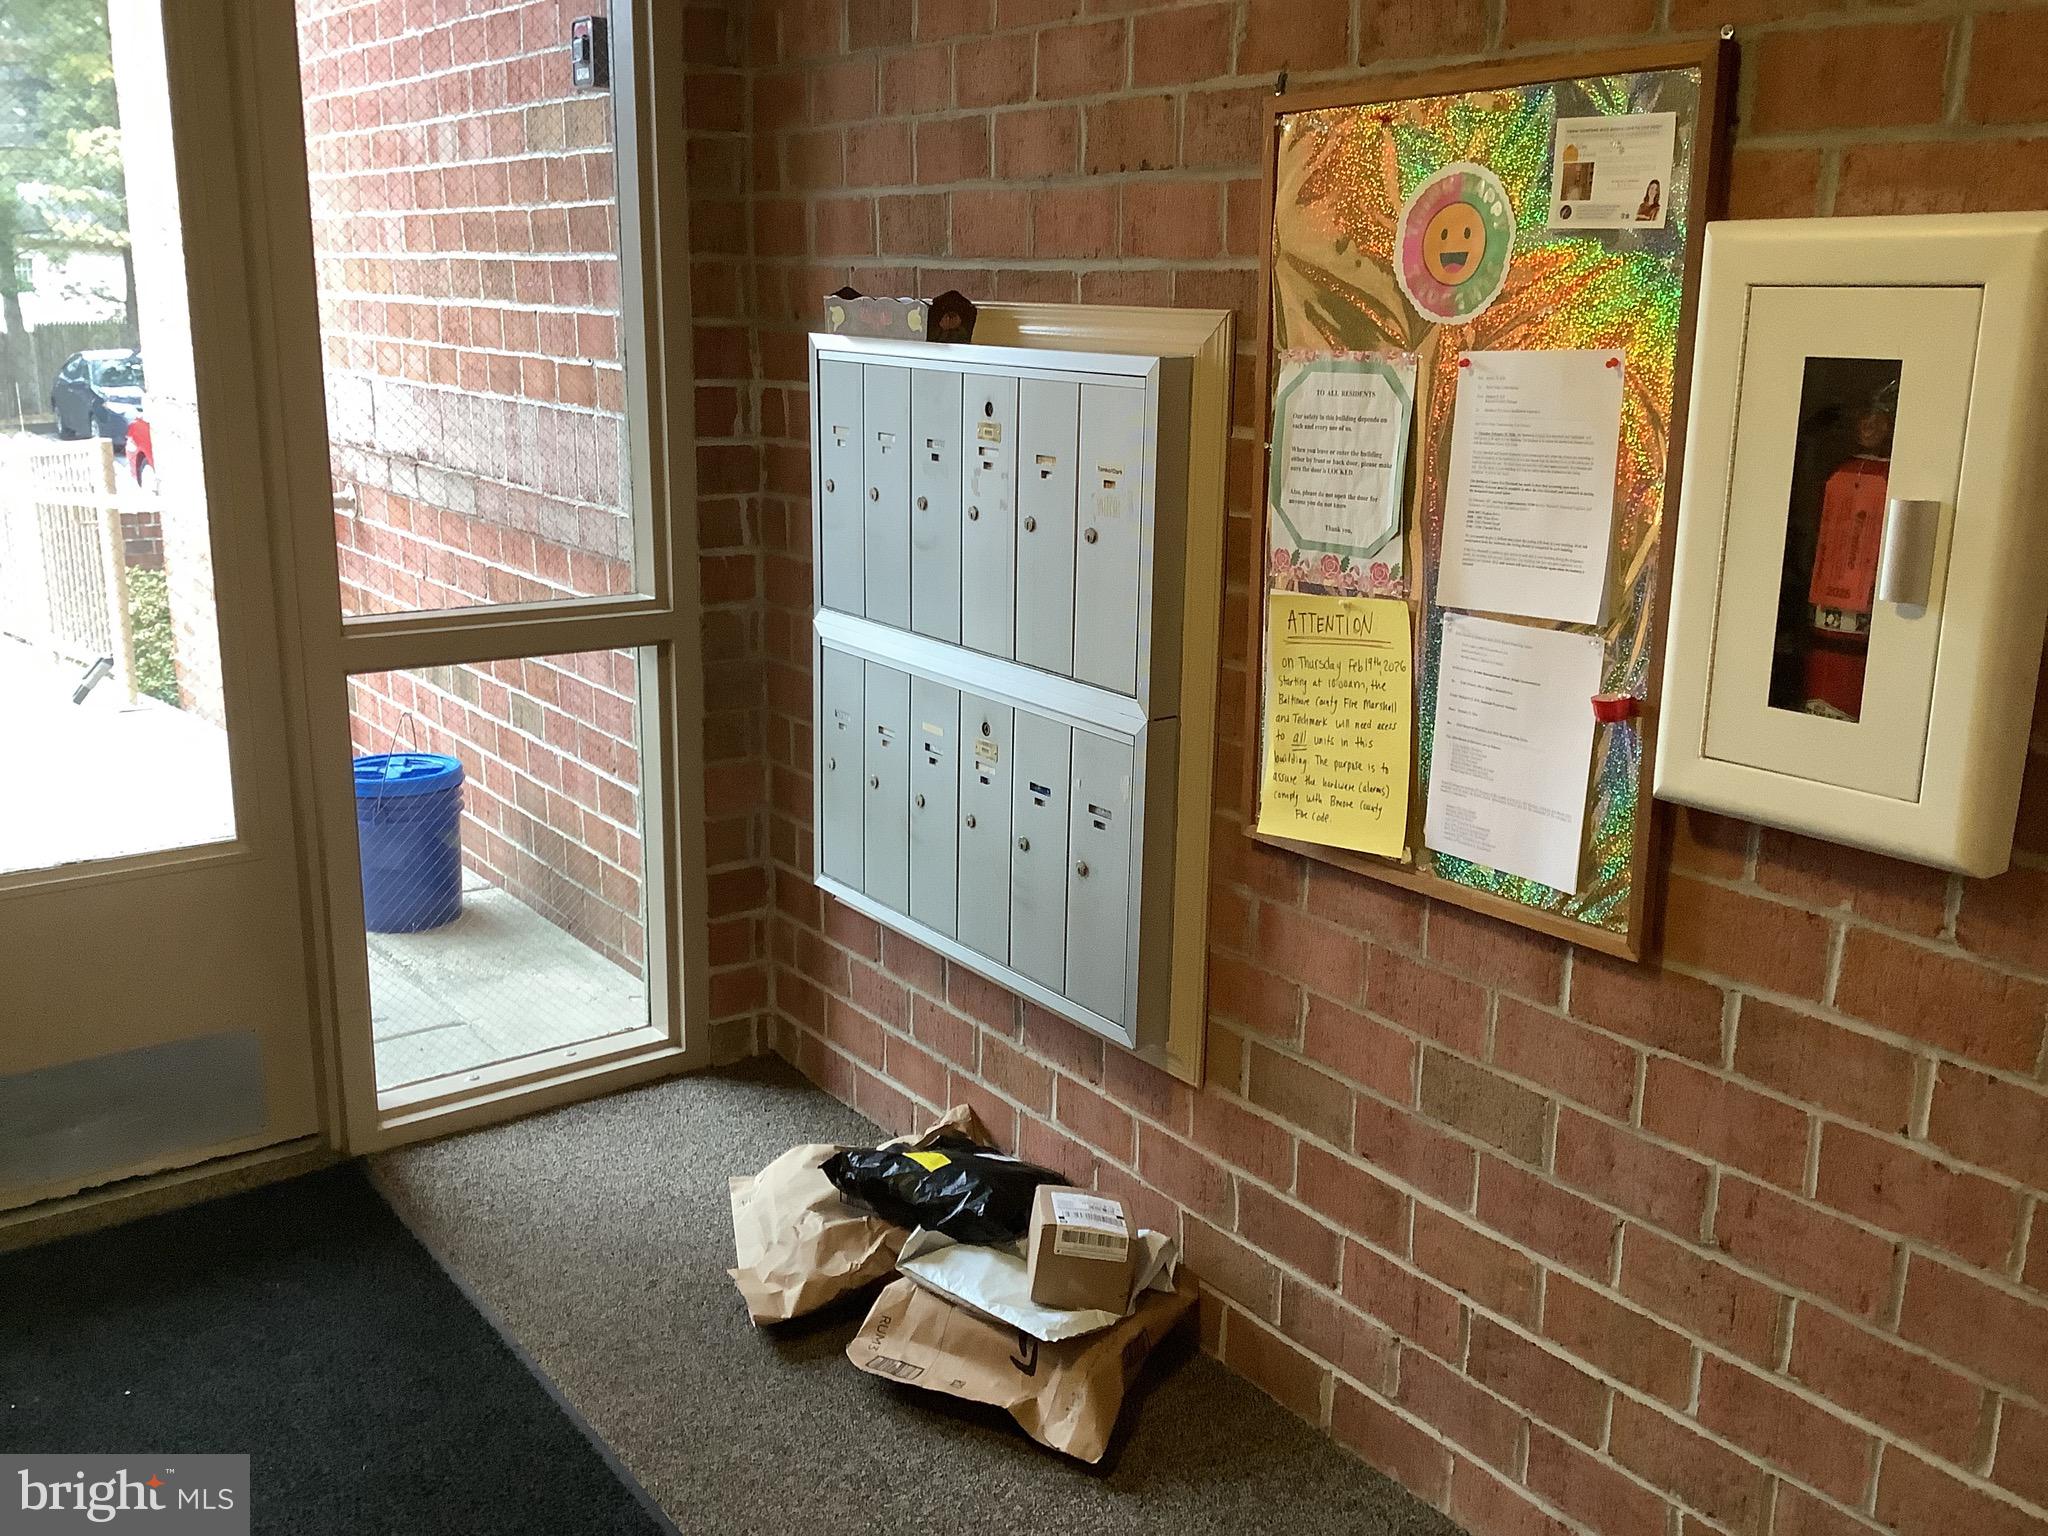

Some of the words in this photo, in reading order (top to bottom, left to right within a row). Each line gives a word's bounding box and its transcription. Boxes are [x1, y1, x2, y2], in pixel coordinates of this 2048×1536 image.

[1328, 389, 1339, 397] ALL
[1341, 390, 1376, 398] RESIDENTS
[1358, 416, 1379, 424] depends
[1288, 609, 1373, 636] ATTENTION
[1298, 655, 1341, 680] Thursday
[1349, 659, 1363, 672] Feb
[1313, 679, 1321, 687] at
[1371, 680, 1386, 691] the
[1279, 693, 1310, 705] Baltimore
[1316, 696, 1338, 715] County
[1344, 698, 1358, 709] Fire
[1276, 714, 1290, 723] and
[1336, 719, 1350, 729] will
[1355, 720, 1372, 730] need
[1276, 729, 1285, 740] to
[1293, 730, 1307, 743] all
[1314, 735, 1334, 746] units
[1341, 738, 1348, 747] in
[1355, 736, 1373, 748] this
[1315, 755, 1328, 766] The
[1334, 759, 1363, 773] purpose
[1368, 763, 1376, 773] is
[1381, 762, 1389, 774] to
[1273, 772, 1297, 784] assure
[1305, 775, 1315, 786] the
[1274, 791, 1299, 807] comply
[1307, 793, 1322, 804] with
